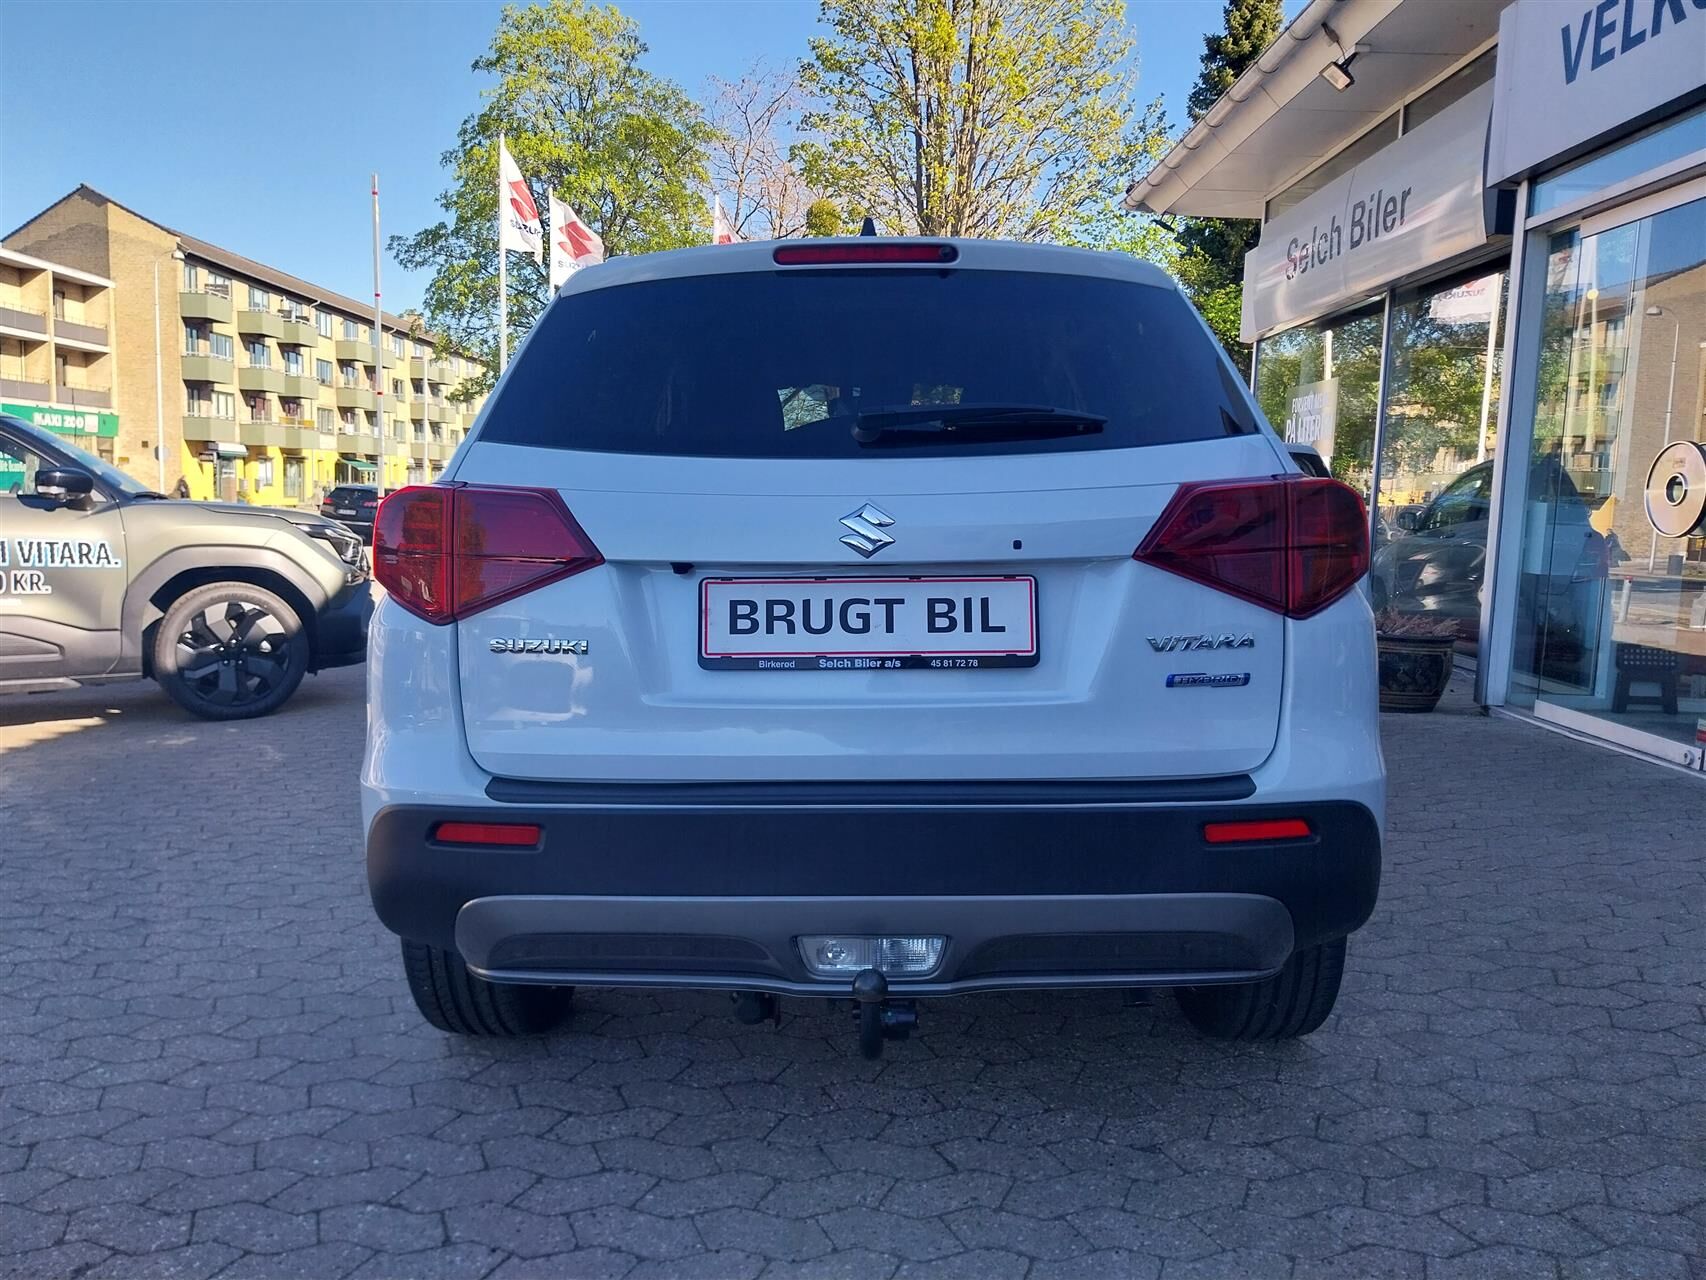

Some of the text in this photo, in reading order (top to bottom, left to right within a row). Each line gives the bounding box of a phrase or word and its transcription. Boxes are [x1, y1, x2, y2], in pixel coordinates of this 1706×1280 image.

[1561, 0, 1706, 86] VELK
[1286, 187, 1412, 281] Selch Biler
[63, 414, 85, 429] ZOO
[17, 540, 119, 565] VITARA.
[13, 573, 49, 591] KR.
[728, 596, 1006, 635] BRUGT BIL
[489, 637, 589, 655] SUZUKI
[1146, 633, 1255, 652] VITARA
[819, 659, 851, 668] Selch
[854, 659, 882, 668] Biler
[884, 659, 901, 668] a/s
[931, 659, 942, 667] 45
[943, 659, 953, 667] 81
[955, 659, 966, 667] 72
[968, 659, 978, 667] 78
[1179, 675, 1242, 685] HYBRID
